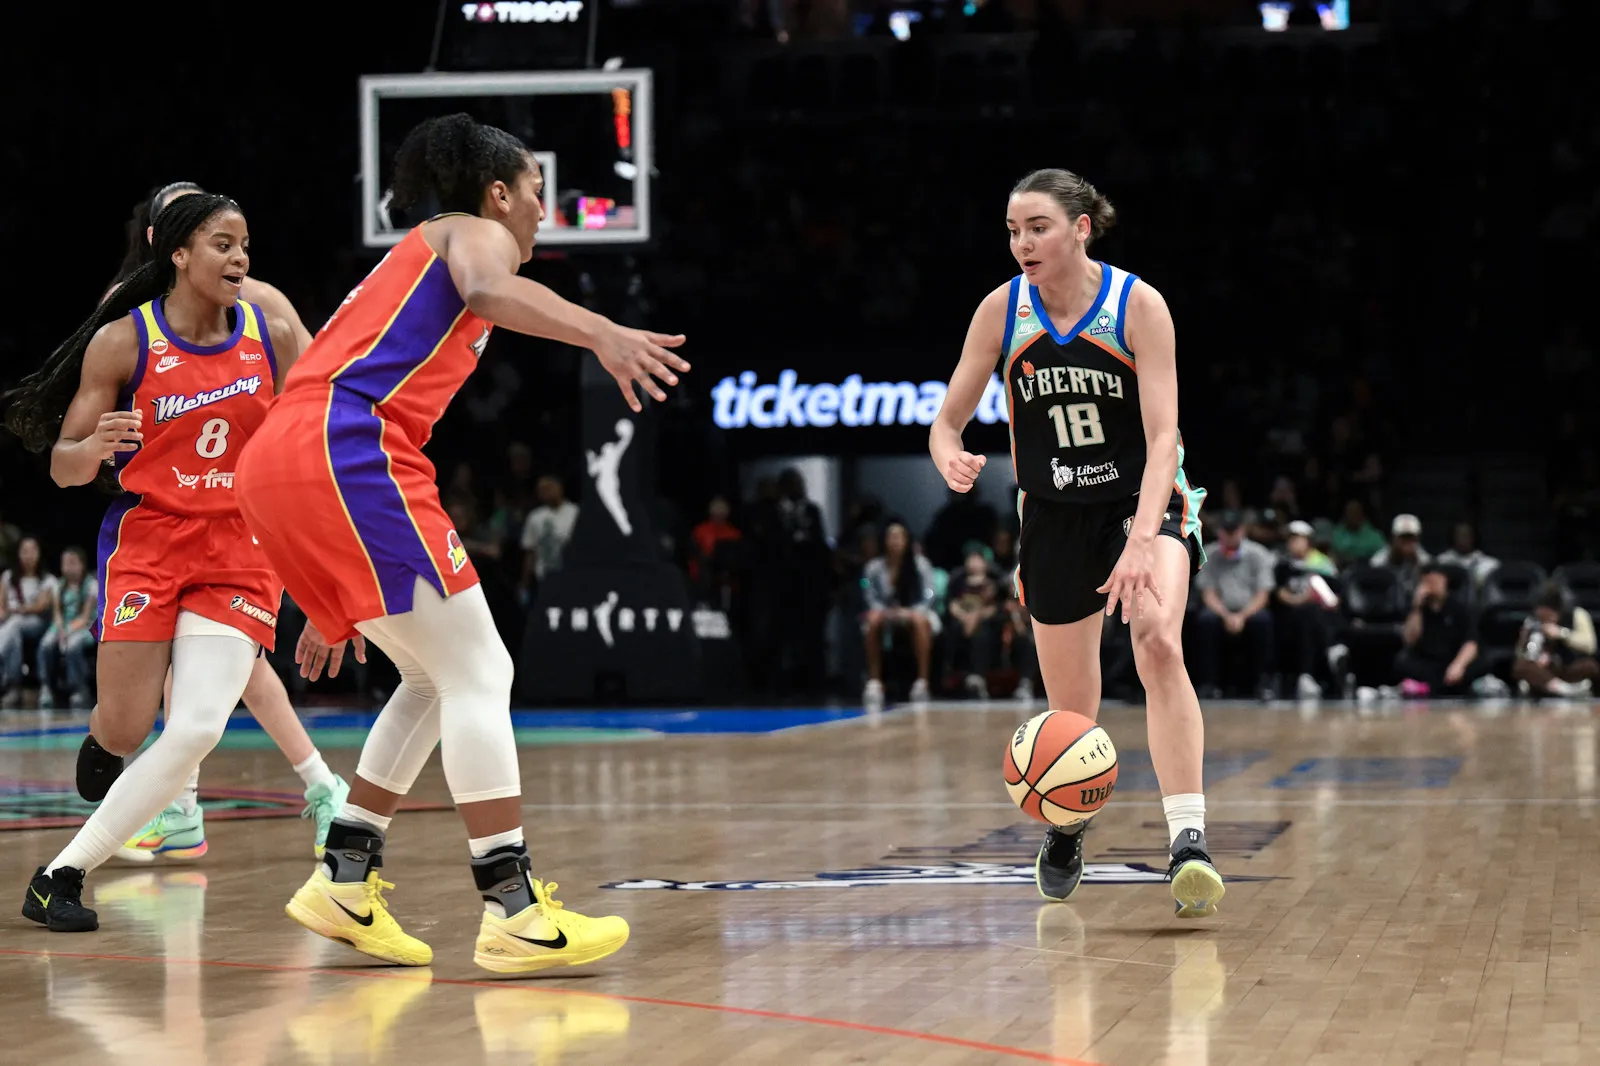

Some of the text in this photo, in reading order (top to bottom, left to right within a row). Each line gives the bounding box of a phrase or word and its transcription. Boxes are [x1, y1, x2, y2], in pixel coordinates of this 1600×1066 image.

[1019, 322, 1036, 333] NIKE
[160, 356, 179, 366] NIKE
[1017, 366, 1124, 403] LIBERTY
[151, 375, 262, 425] Mercury
[711, 368, 1010, 429] ticketmat
[1047, 402, 1106, 448] 18
[195, 418, 231, 459] 8
[202, 467, 235, 489] fry
[1076, 461, 1115, 476] Liberty
[1077, 468, 1120, 487] Mutual
[242, 604, 277, 628] WNBA
[1080, 781, 1115, 805] Wil
